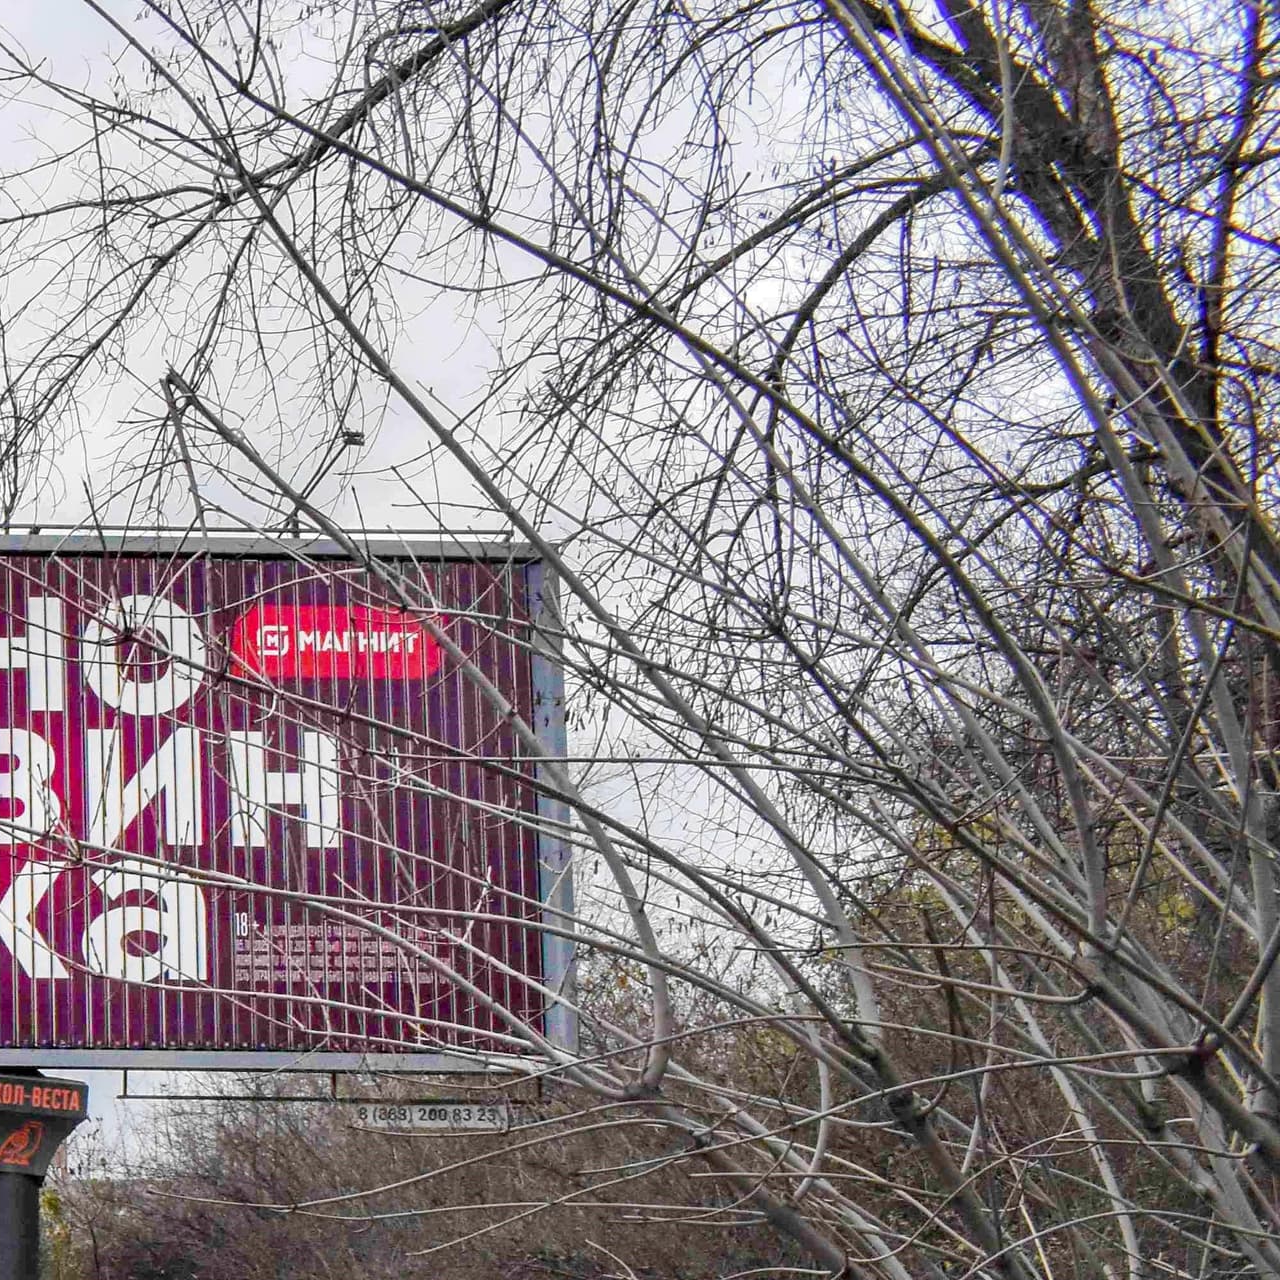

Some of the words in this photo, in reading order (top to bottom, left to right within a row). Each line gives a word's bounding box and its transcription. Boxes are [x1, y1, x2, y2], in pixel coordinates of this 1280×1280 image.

[298, 630, 419, 654] МАГНИТ
[234, 912, 260, 936] 18+
[359, 1106, 369, 1120] 8
[418, 1107, 448, 1122] 200
[453, 1108, 473, 1122] 83
